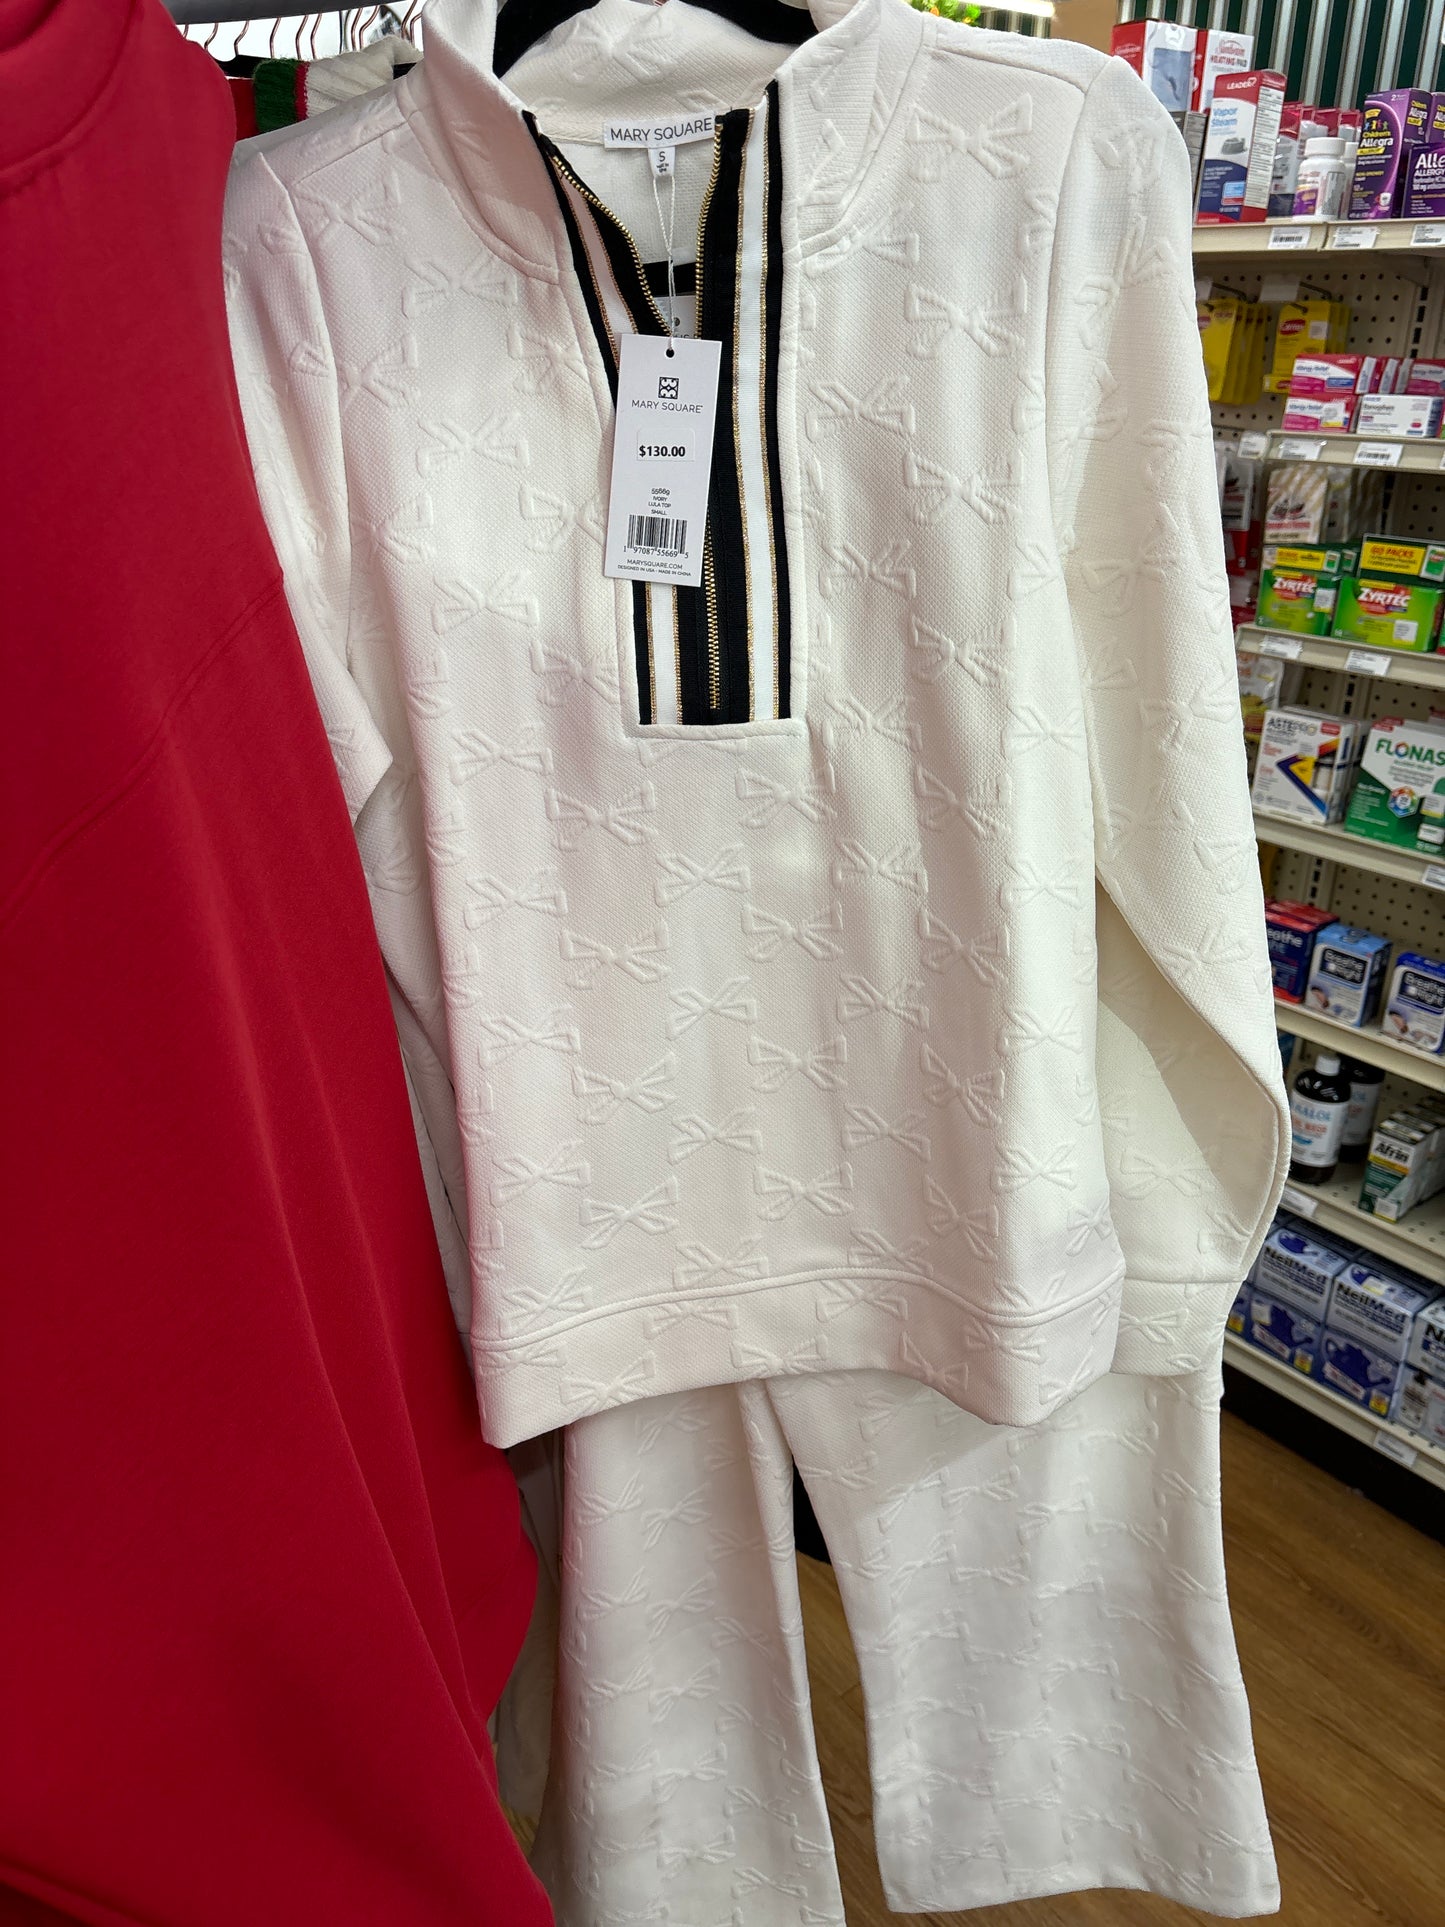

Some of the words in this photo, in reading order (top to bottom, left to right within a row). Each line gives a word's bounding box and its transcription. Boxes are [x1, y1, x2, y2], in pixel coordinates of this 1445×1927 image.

[1213, 107, 1238, 116] Vapor
[610, 128, 651, 141] MARY
[654, 117, 713, 141] SQUARE
[1211, 119, 1238, 127] Steam
[1361, 138, 1393, 148] Allegra
[658, 151, 666, 162] S
[632, 400, 659, 410] MARY
[661, 402, 702, 413] SQUARE
[639, 445, 686, 458] $130.00
[633, 546, 654, 555] 97087
[657, 549, 678, 558] 55669
[627, 559, 683, 569] MARYSQUARE.COM
[1273, 577, 1317, 594] ZYRTEC
[1358, 587, 1411, 607] ZYRTEC
[1324, 951, 1364, 971] Breathe
[1375, 1142, 1409, 1161] Afrin
[1265, 1246, 1327, 1284] NeilMed
[1337, 1283, 1406, 1323] NeilMed
